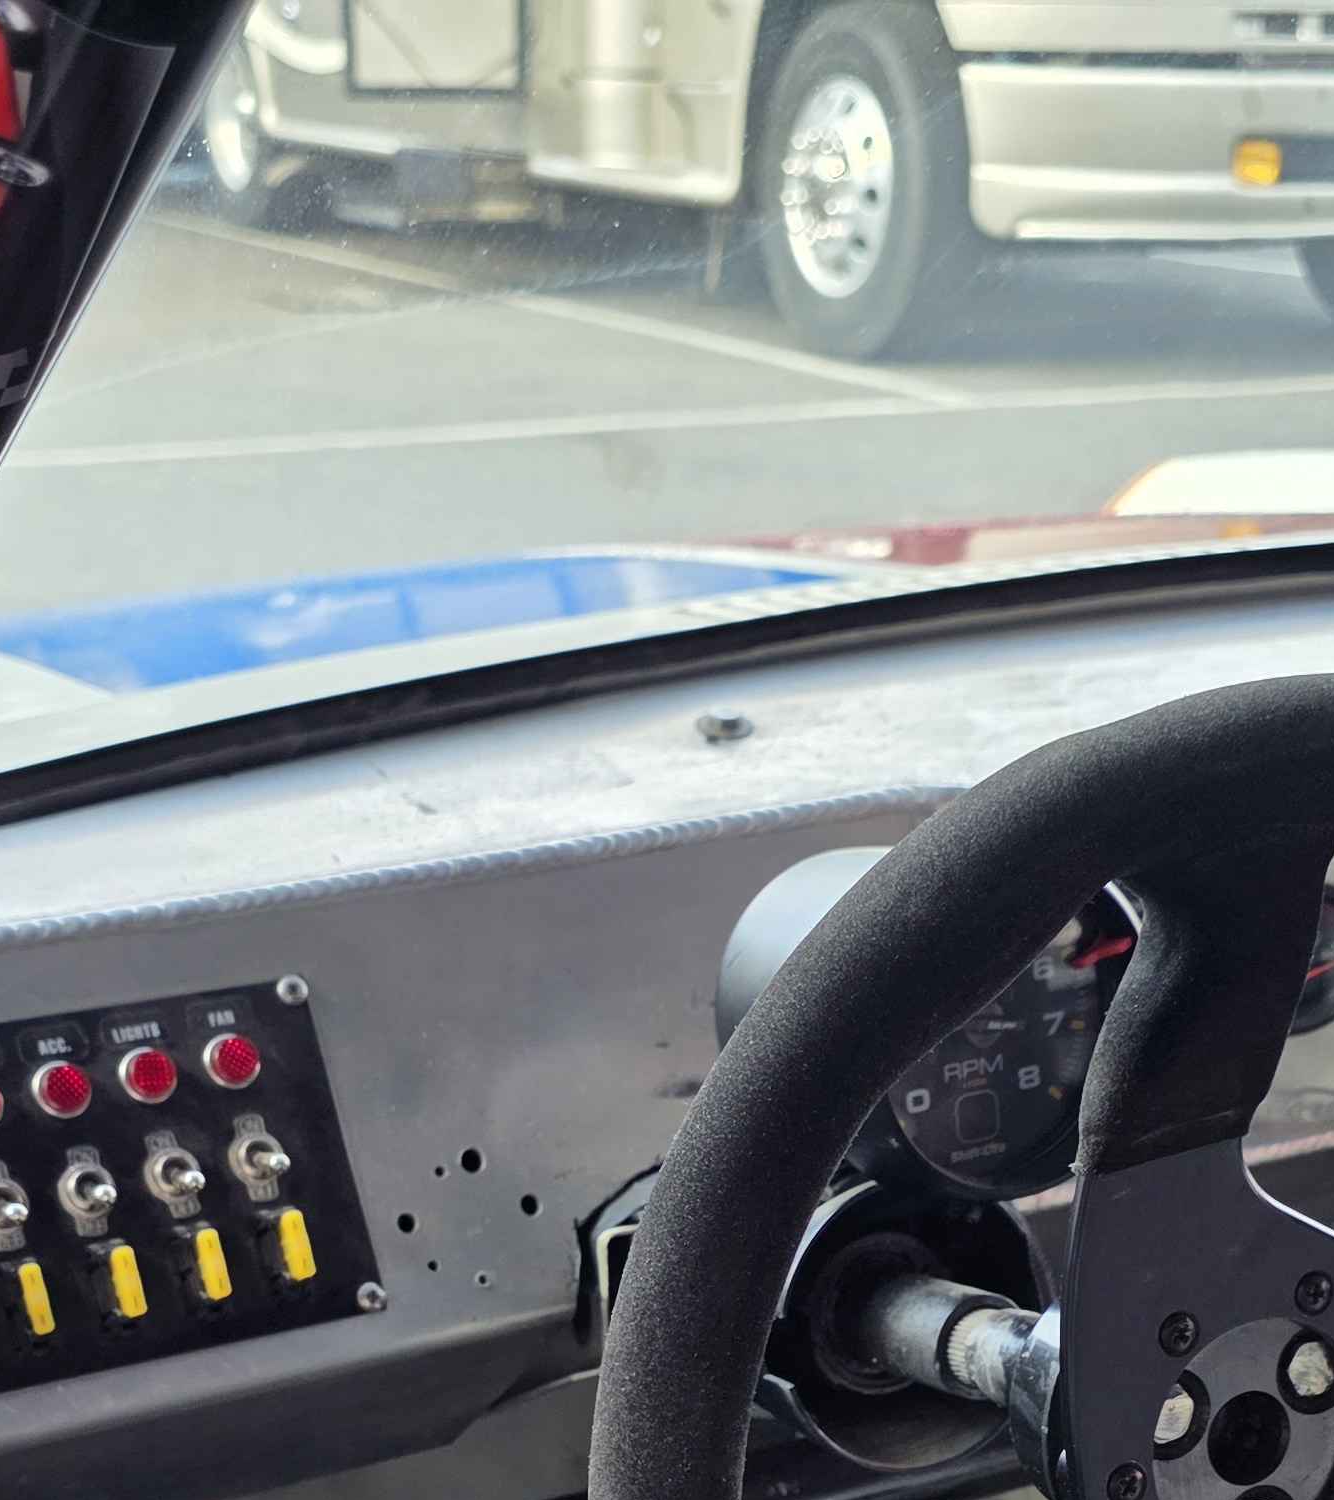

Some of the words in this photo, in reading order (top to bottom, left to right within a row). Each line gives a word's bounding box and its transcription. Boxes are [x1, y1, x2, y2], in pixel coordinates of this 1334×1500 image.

[1032, 956, 1055, 981] 6
[207, 1009, 235, 1028] FAN
[1043, 1010, 1065, 1036] 7
[111, 1020, 161, 1044] LIGHTS
[943, 1054, 1004, 1083] RPM
[1018, 1065, 1041, 1090] 8
